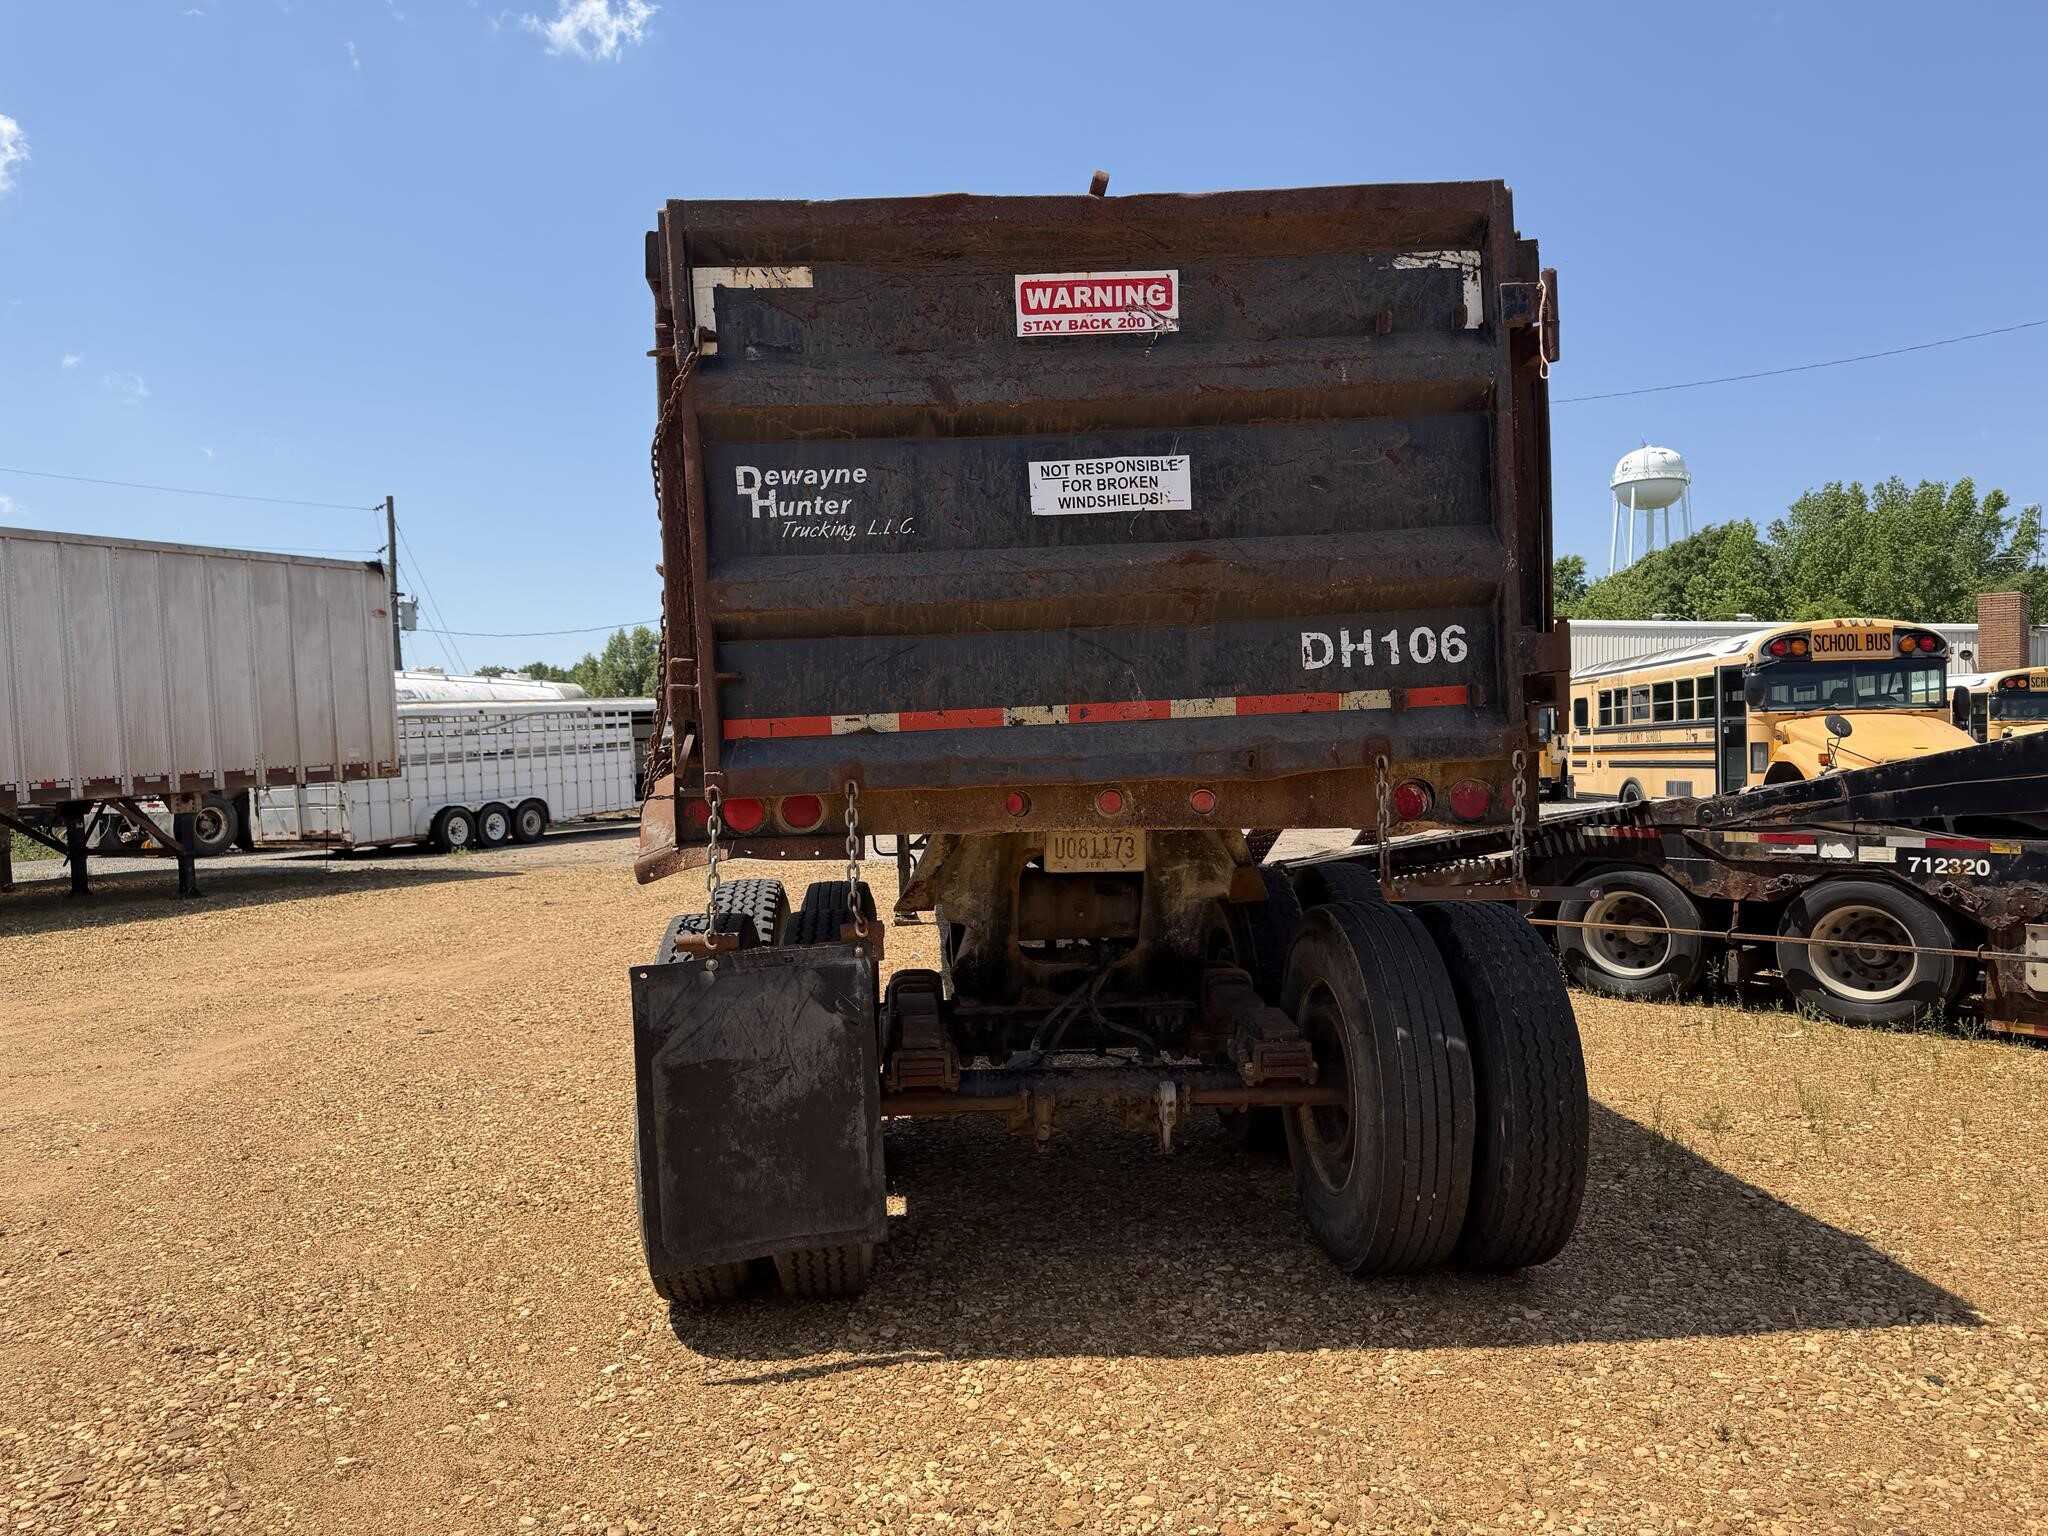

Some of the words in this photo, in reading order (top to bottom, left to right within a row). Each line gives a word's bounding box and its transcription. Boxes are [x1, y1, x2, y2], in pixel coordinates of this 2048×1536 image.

[1026, 285, 1166, 310] WARNING
[1022, 320, 1063, 332] STAY
[1068, 318, 1112, 330] BACK
[1117, 317, 1146, 328] 200
[1040, 464, 1070, 477] NOT
[1075, 459, 1178, 475] RESPONSIBLE
[735, 465, 867, 495] Dewayne
[1062, 480, 1092, 492] FOR
[1097, 476, 1158, 491] BROKEN
[751, 489, 852, 518] Hunter
[1058, 492, 1163, 509] WINDSHIELDS!
[1300, 624, 1468, 670] DH106
[1813, 633, 1863, 652] SCHOOL
[1866, 632, 1892, 651] BUS
[2031, 676, 2048, 688] SCH
[1722, 807, 1733, 816] 14
[1907, 856, 1991, 876] 712320
